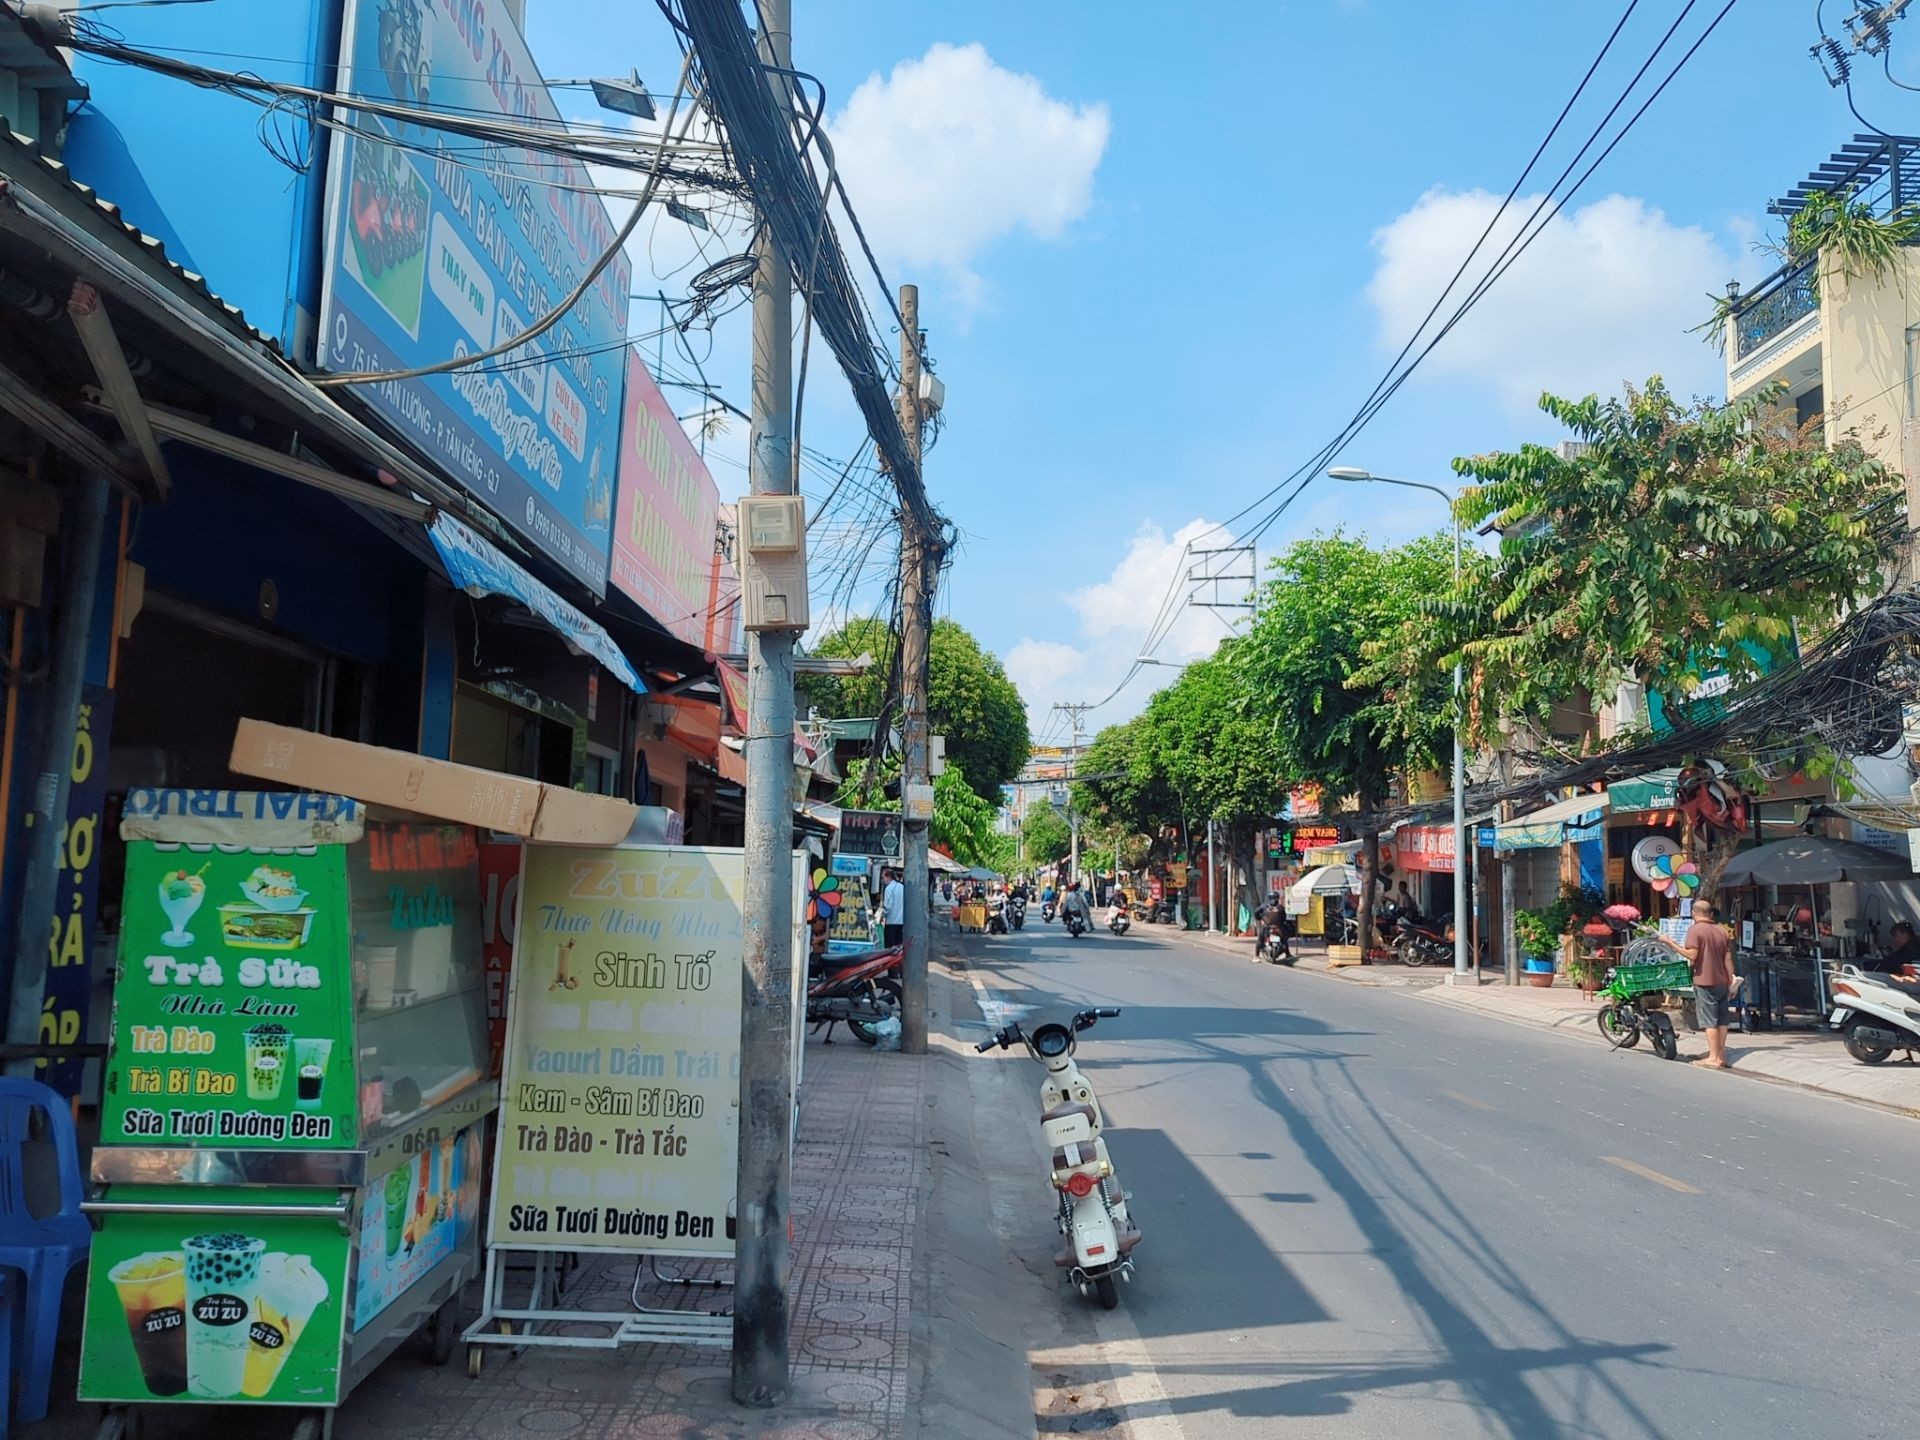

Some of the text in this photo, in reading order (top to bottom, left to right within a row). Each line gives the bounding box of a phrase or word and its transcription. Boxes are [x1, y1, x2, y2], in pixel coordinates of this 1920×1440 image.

[434, 136, 472, 233] MUA
[475, 195, 507, 274] BÁN
[507, 244, 527, 303] XE
[442, 245, 485, 317] THAY PIN
[630, 487, 672, 578] BÁNH
[144, 955, 321, 989] Trà Sữa
[594, 950, 716, 991] Sinh Tố
[161, 994, 299, 1017] Nhà Làm
[131, 1025, 215, 1054] Trà Đào
[609, 1043, 665, 1077] Dầm
[129, 1067, 238, 1096] Trà Bí Đao
[519, 1083, 567, 1113] Kem
[585, 1086, 632, 1116] Sâm
[637, 1087, 661, 1117] Bí
[664, 1089, 704, 1118] Đao
[123, 1107, 332, 1140] Sữa Tươi Đường Đen
[518, 1124, 548, 1152] Trà
[554, 1125, 593, 1153] Đào
[615, 1128, 645, 1155] Trà
[652, 1124, 688, 1157] Tắc
[509, 1204, 714, 1240] Sữa Tươi Đường Đen
[146, 1319, 163, 1332] ZU
[165, 1314, 181, 1328] ZU
[199, 1307, 242, 1320] ZU ZU
[250, 1327, 265, 1341] ZU
[264, 1334, 280, 1347] ZU
